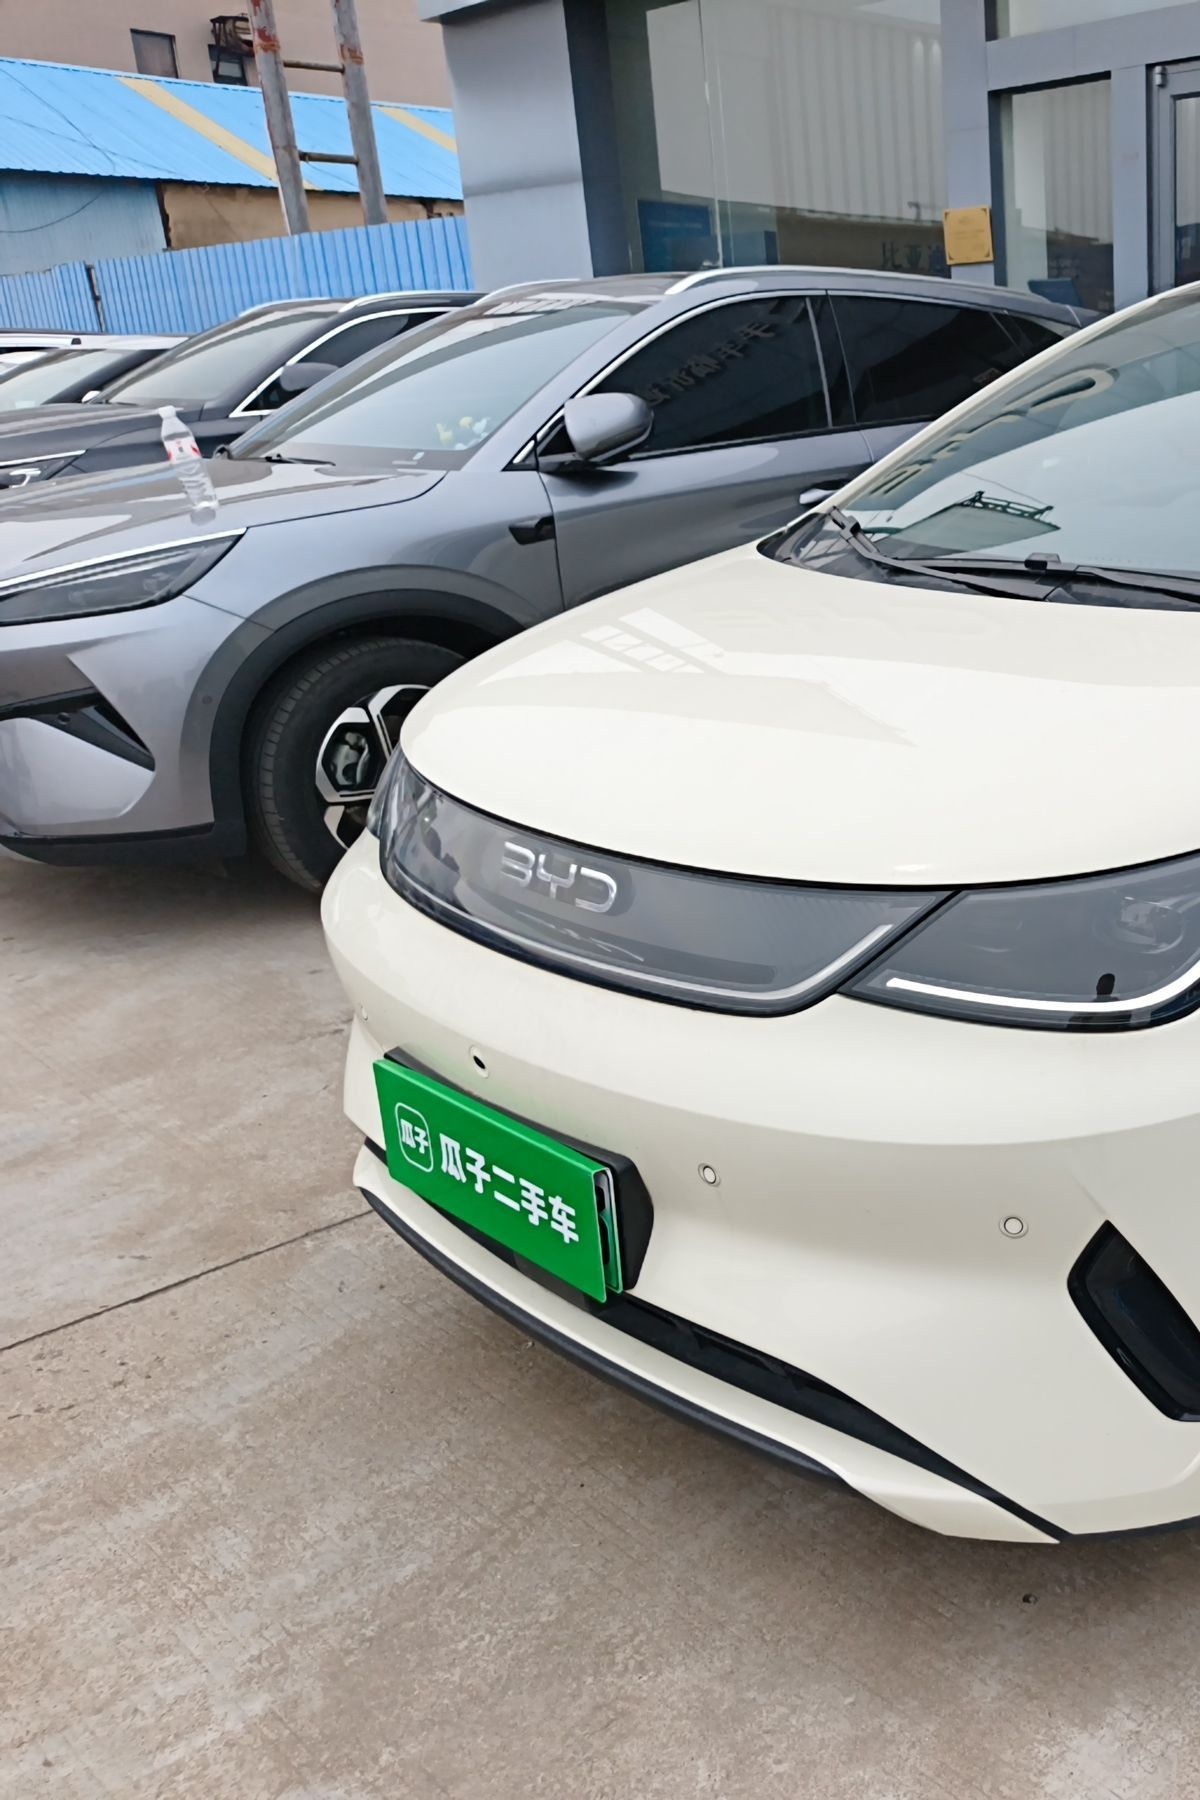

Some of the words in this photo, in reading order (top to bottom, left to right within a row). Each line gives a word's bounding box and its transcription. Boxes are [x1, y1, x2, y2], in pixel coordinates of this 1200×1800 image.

[500, 841, 617, 913] BYD
[400, 1118, 430, 1154] 瓜子
[439, 1132, 580, 1244] 瓜子二手车
